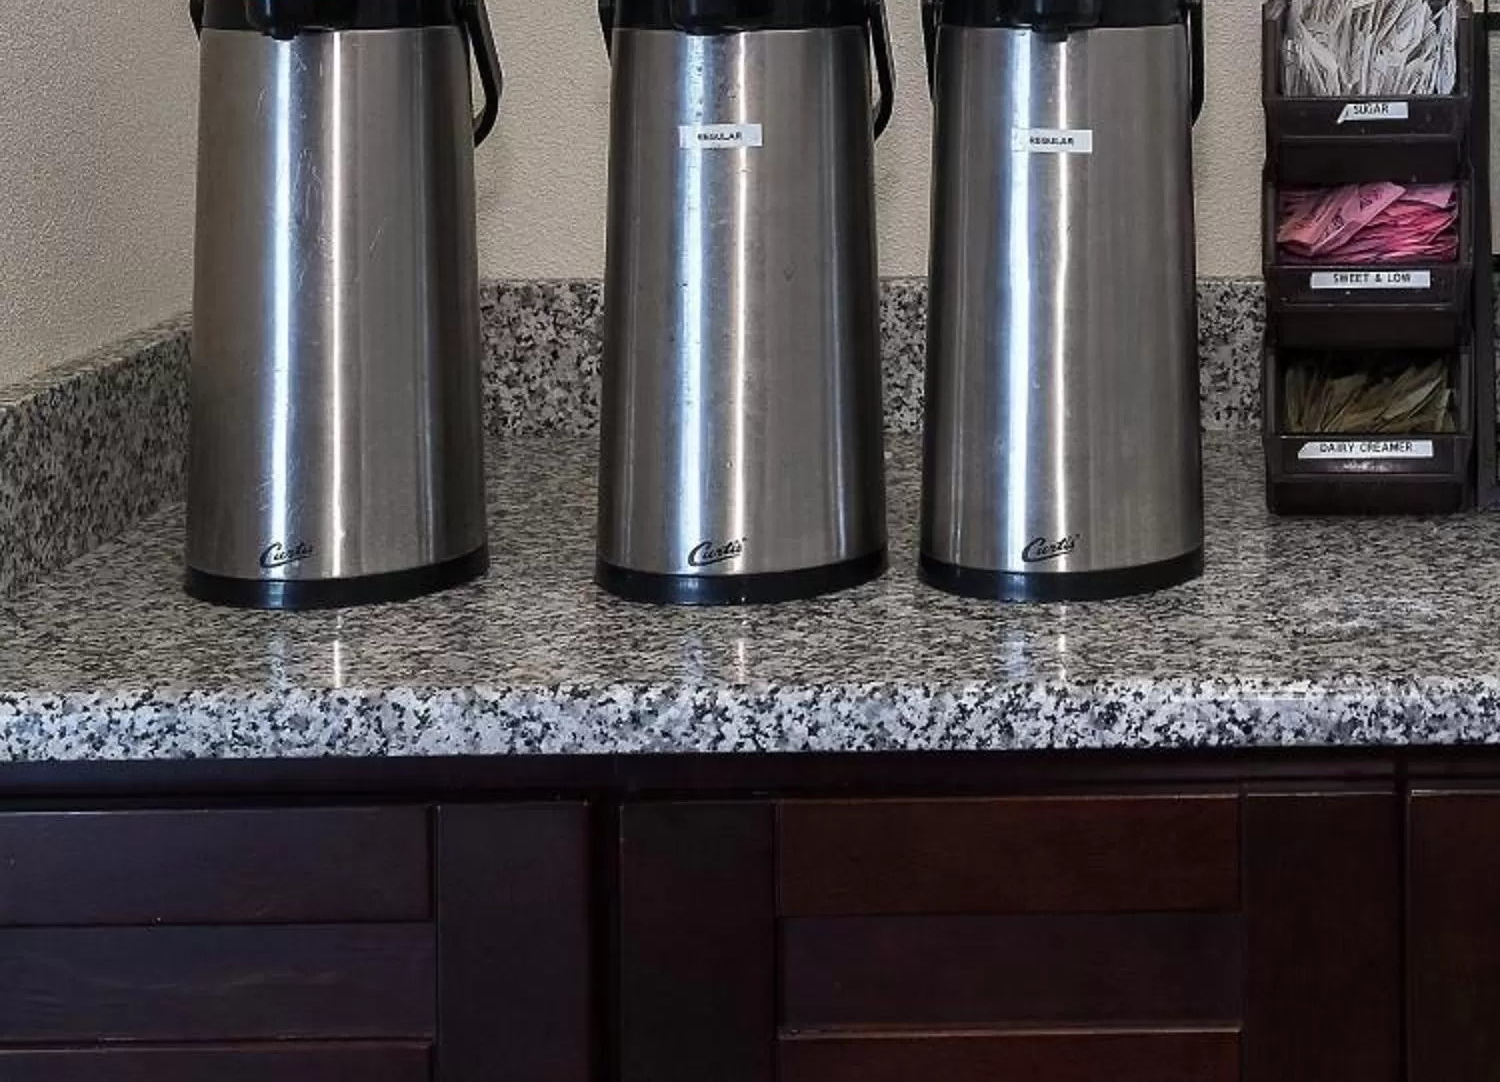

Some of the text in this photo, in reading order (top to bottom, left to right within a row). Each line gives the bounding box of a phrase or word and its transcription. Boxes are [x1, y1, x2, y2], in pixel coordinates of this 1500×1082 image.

[1353, 103, 1389, 115] SUGAR
[697, 131, 742, 141] REGULAR
[1029, 136, 1074, 146] REGULAR
[1333, 273, 1370, 283] SWEET
[1387, 273, 1411, 283] LOW
[1320, 441, 1413, 453] DAIRY CREAMER
[259, 540, 313, 569] Curtis
[687, 540, 742, 567] Curtis
[1021, 536, 1075, 563] Curtis
